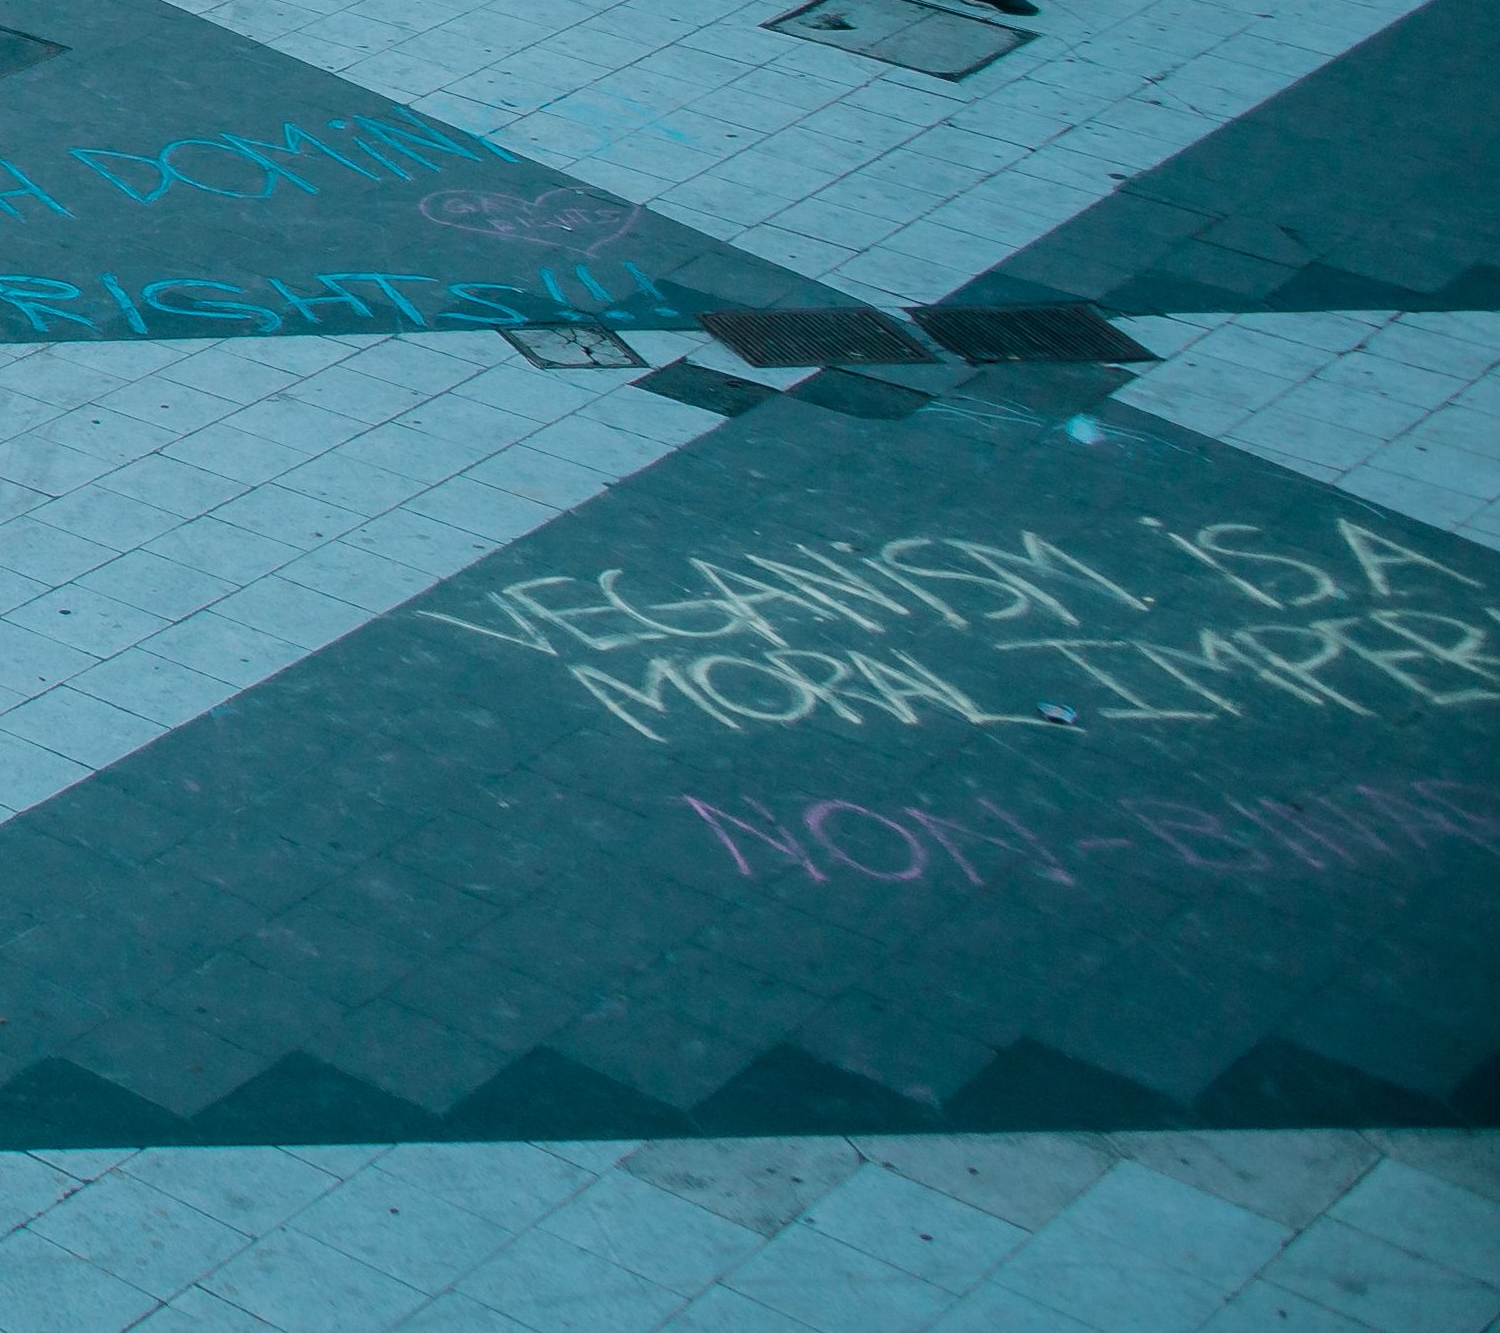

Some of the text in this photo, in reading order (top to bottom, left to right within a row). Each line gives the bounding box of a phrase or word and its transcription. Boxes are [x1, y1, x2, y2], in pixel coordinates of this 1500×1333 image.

[418, 515, 1482, 656] VEGANISM IS A
[568, 608, 1500, 742] MORAL IMPER
